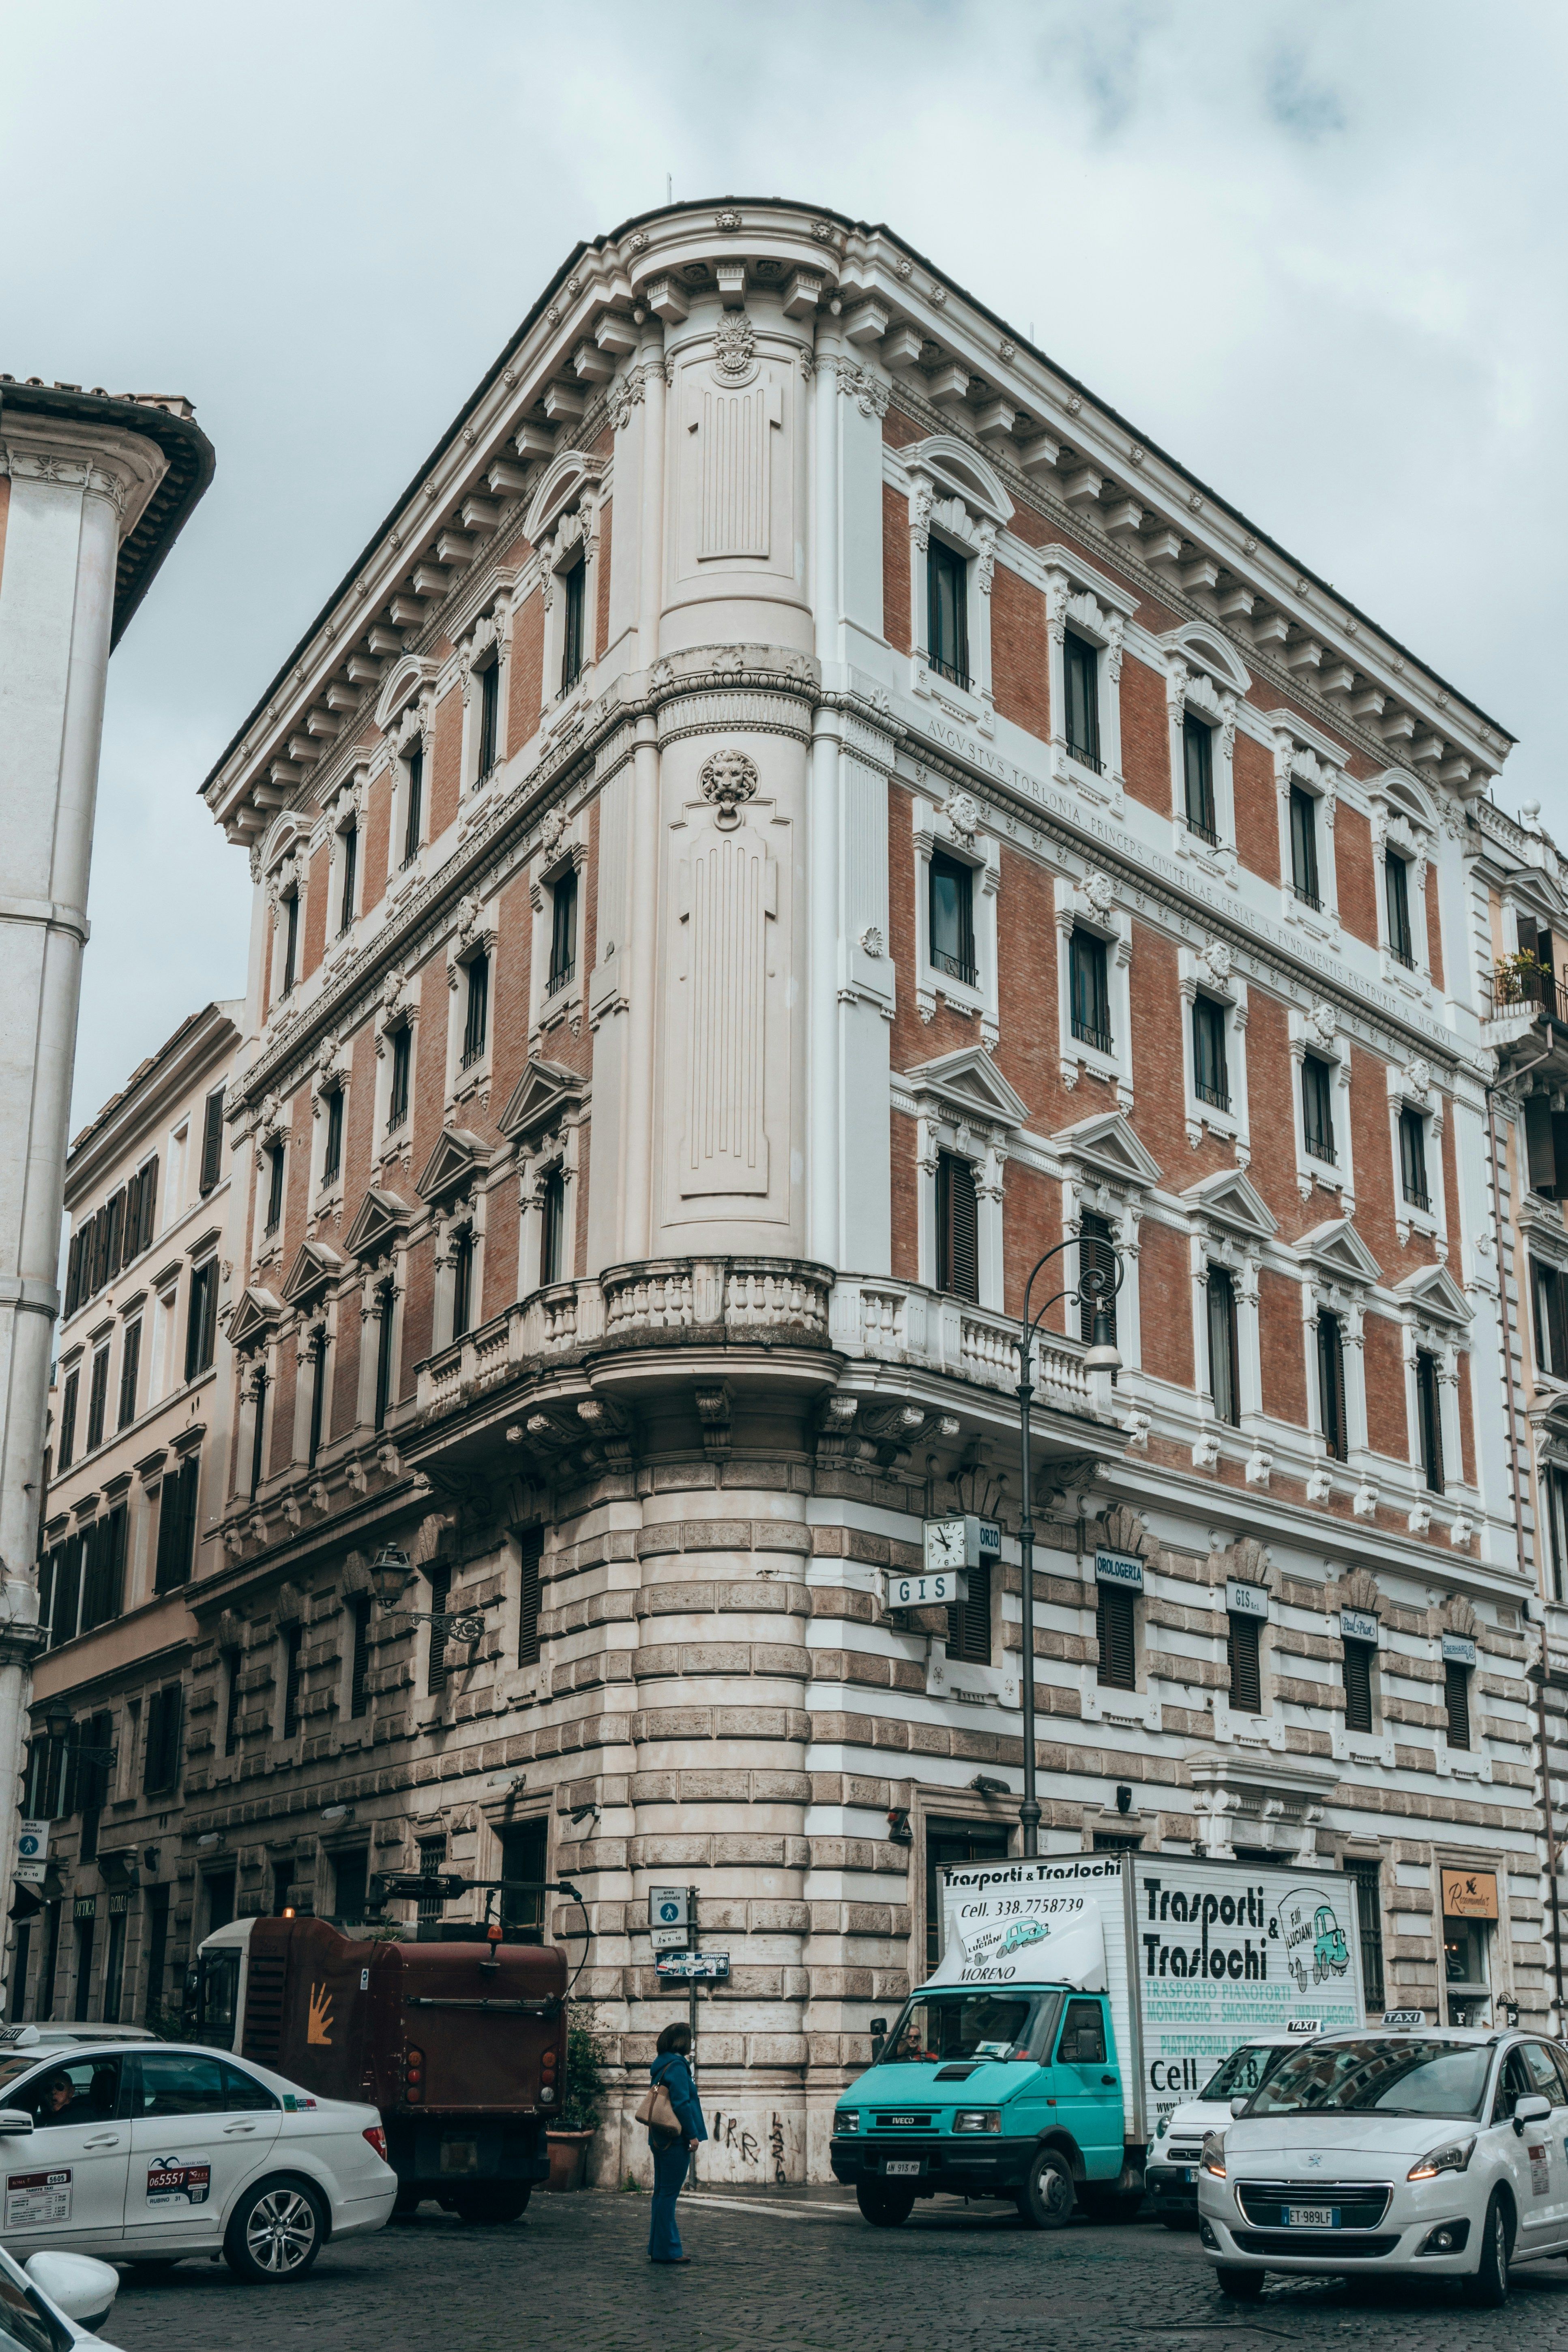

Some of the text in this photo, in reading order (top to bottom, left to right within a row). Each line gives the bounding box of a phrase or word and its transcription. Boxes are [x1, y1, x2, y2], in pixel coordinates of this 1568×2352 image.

[927, 720, 1004, 776] AVGVSTVS
[1012, 770, 1081, 824] TORLONIA
[1091, 817, 1143, 860] PRINCEPS
[1152, 855, 1212, 903] CIVITELLAE
[1221, 897, 1256, 929] CESIAE
[1264, 923, 1271, 938] A
[1349, 972, 1396, 1013] EXSTRVXIT
[980, 1527, 999, 1548] ORIO
[1097, 1556, 1142, 1582] OROLOGERIA
[899, 1577, 945, 1602] GIS
[1236, 1589, 1250, 1608] GIS
[1342, 1613, 1375, 1636] Paul Picot
[1443, 1641, 1467, 1654] EBERHARD
[1039, 1836, 1047, 1848] 22
[943, 1859, 1122, 1891] Trasporti & Traslochi
[74, 1895, 127, 1917] OTTICA ROMA
[961, 1898, 1083, 1918] Cell. 338.7758739
[1143, 1878, 1264, 1928] Trasporti
[1268, 1917, 1279, 1939] &
[1287, 1921, 1312, 1949] LUCIANI
[968, 1934, 1002, 1953] LUCIANI
[1143, 1933, 1267, 1980] Traslochi
[958, 1966, 1016, 1981] MORENO
[1145, 1981, 1291, 2001] TRASPORTO PIANOFORTI
[1147, 2001, 1211, 2022] MONTAGGIO
[1221, 2003, 1285, 2024] SMONTAGGIO
[1294, 2005, 1354, 2025] IMBALLAGGIO
[1386, 2013, 1418, 2022] TAXI
[2, 2029, 23, 2039] TAXI
[1291, 2021, 1314, 2031] TAXI
[1160, 2035, 1229, 2056] PIATTAFORMA
[1150, 2058, 1202, 2092] Cell
[897, 2164, 909, 2172] 913
[49, 2175, 64, 2183] 5605
[149, 2172, 184, 2187] 065551
[1290, 2210, 1332, 2223] ET 989LF
